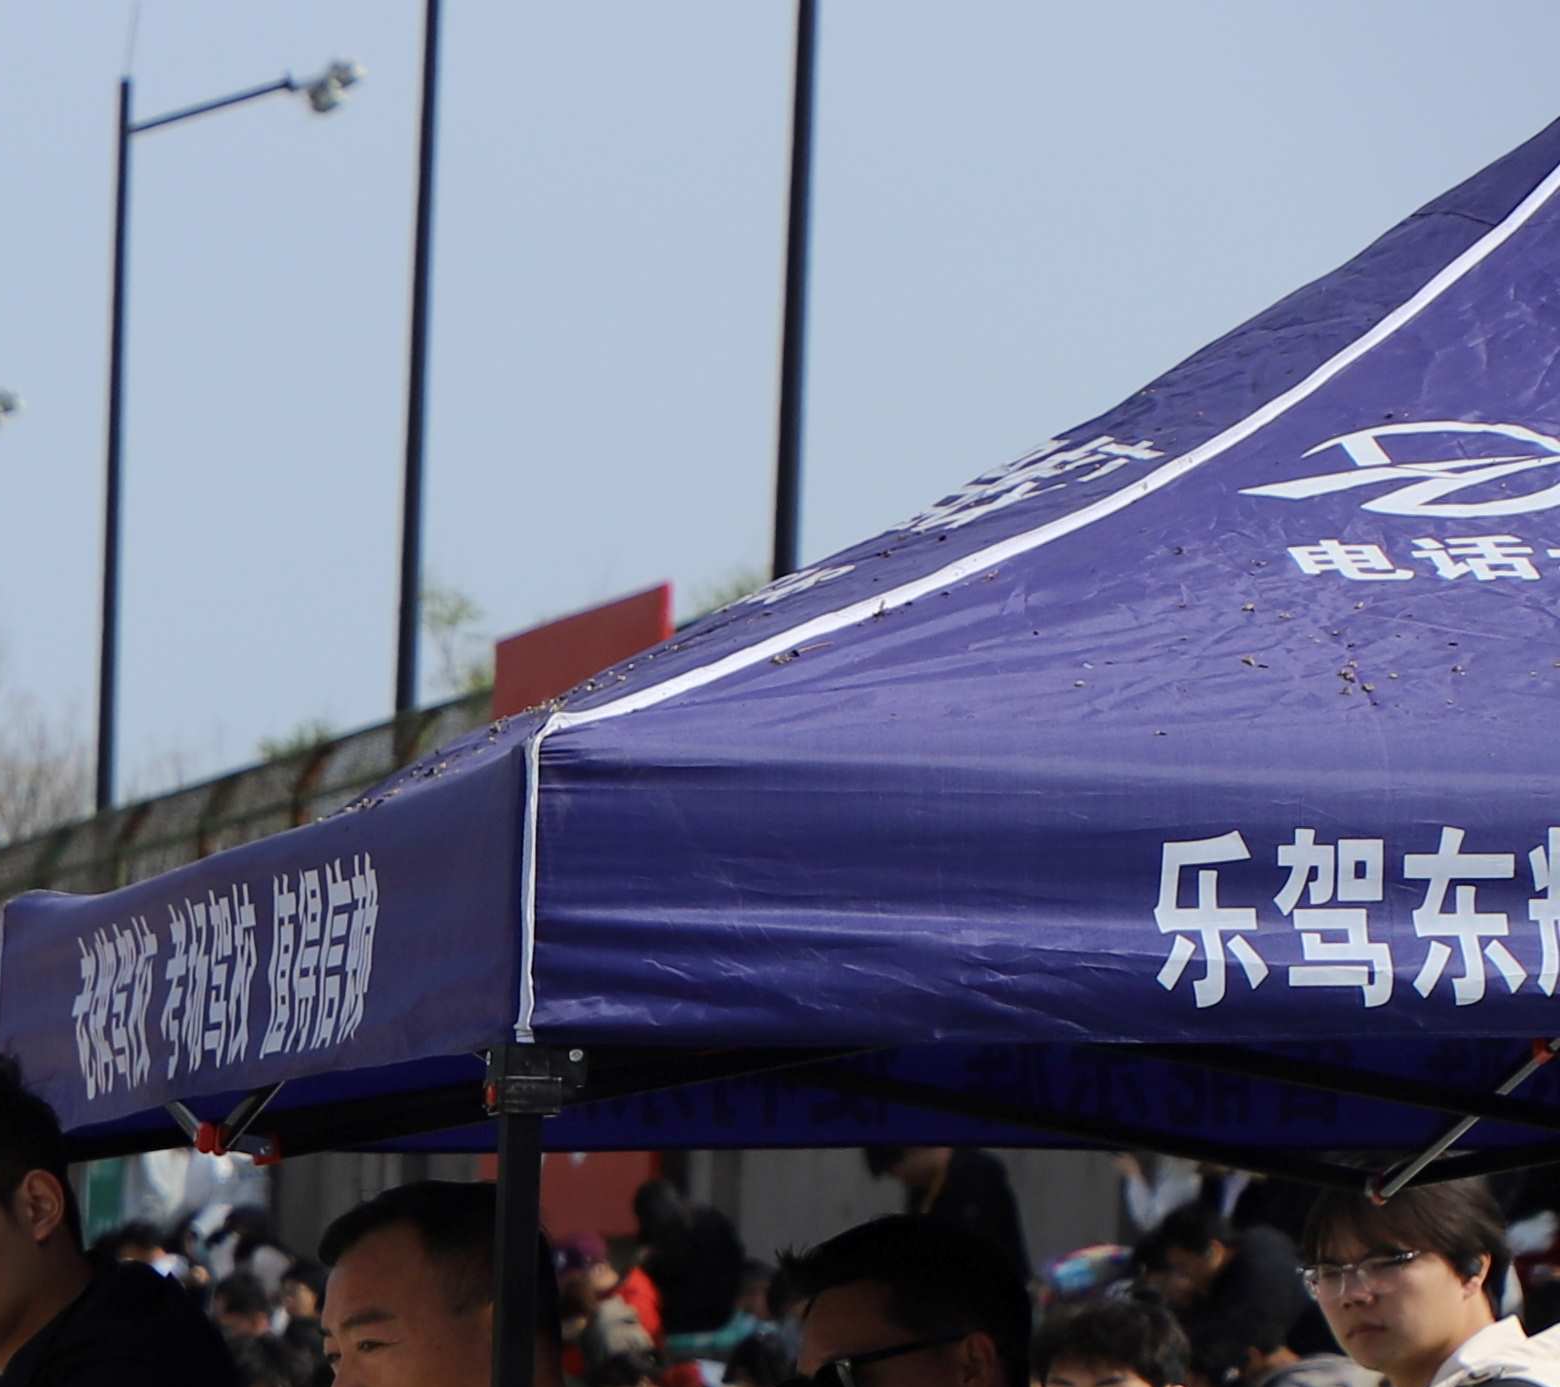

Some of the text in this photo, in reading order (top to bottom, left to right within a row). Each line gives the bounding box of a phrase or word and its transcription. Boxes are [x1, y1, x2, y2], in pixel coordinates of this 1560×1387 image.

[1287, 536, 1560, 582] 电话
[260, 851, 380, 1060] 值得信赖
[1153, 825, 1560, 1009] 乐驾东
